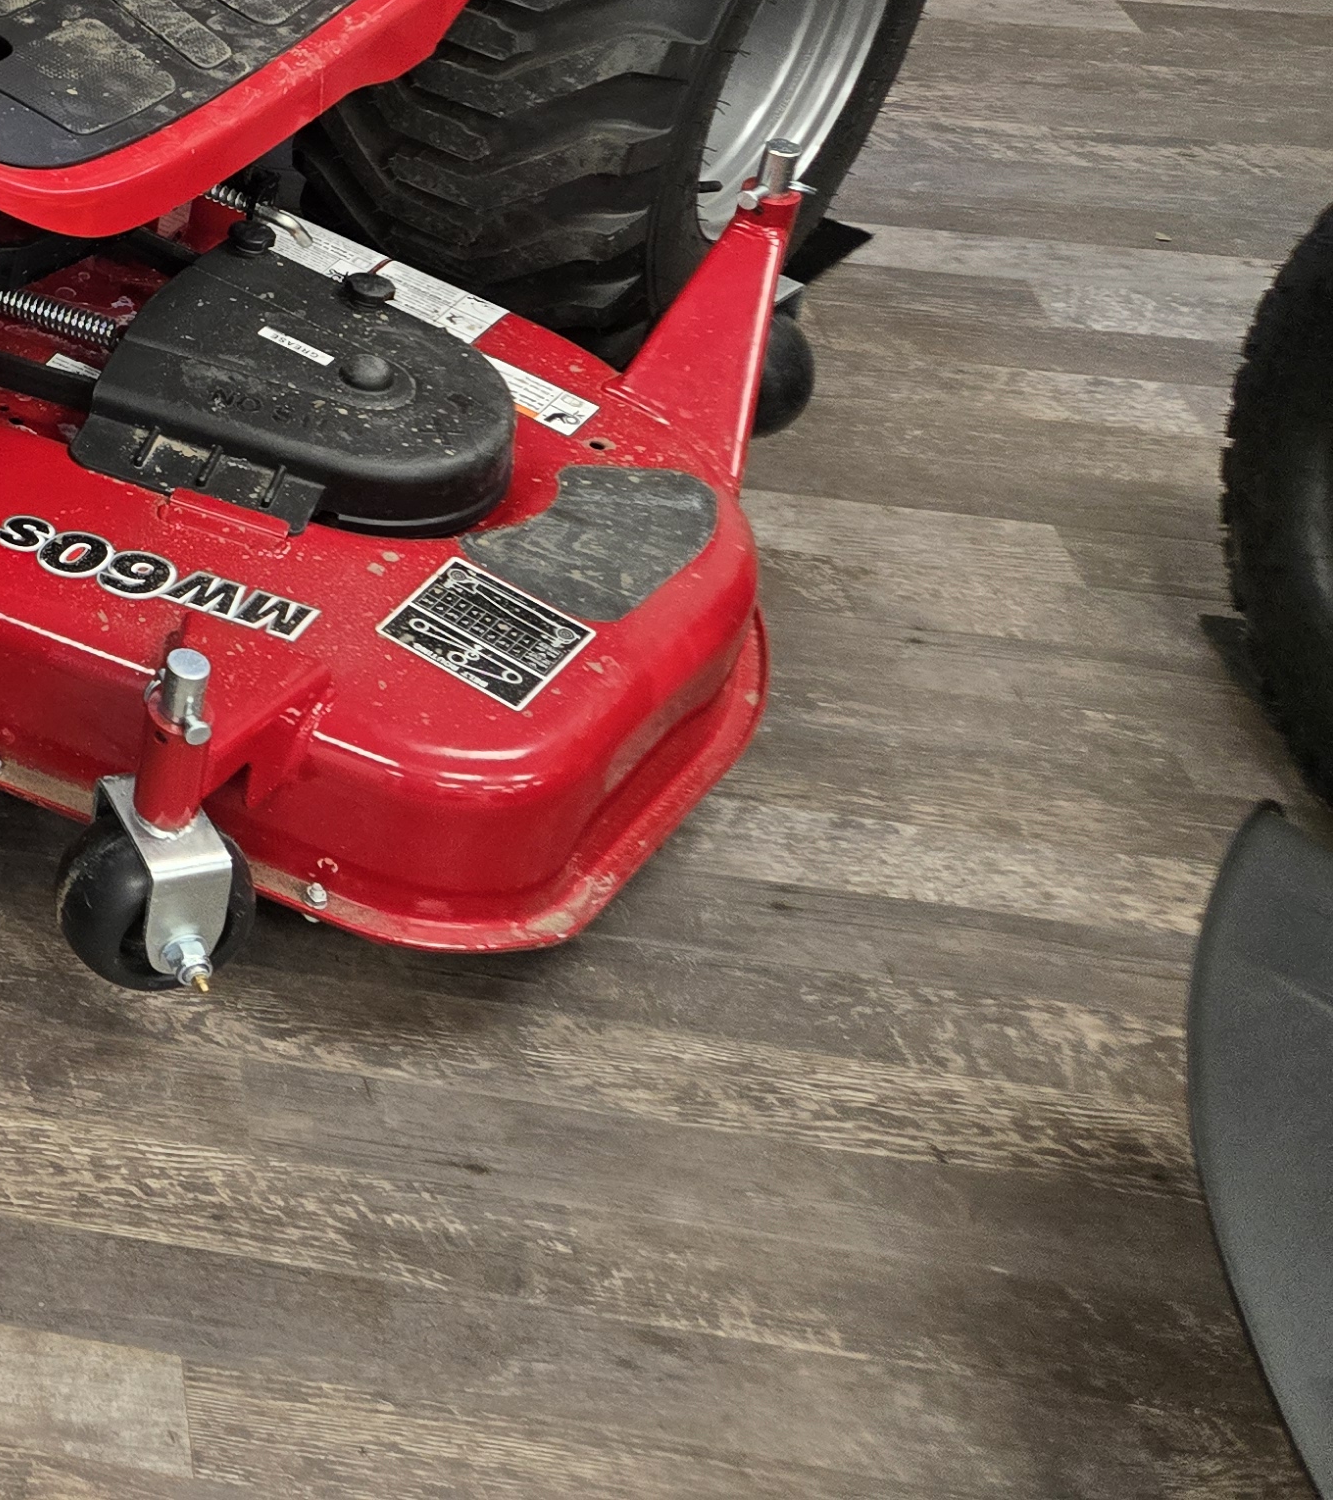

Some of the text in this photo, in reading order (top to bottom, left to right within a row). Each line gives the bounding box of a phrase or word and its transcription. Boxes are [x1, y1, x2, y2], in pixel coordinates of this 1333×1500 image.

[270, 332, 320, 359] GREASE
[412, 643, 489, 688] BELT ROUTING
